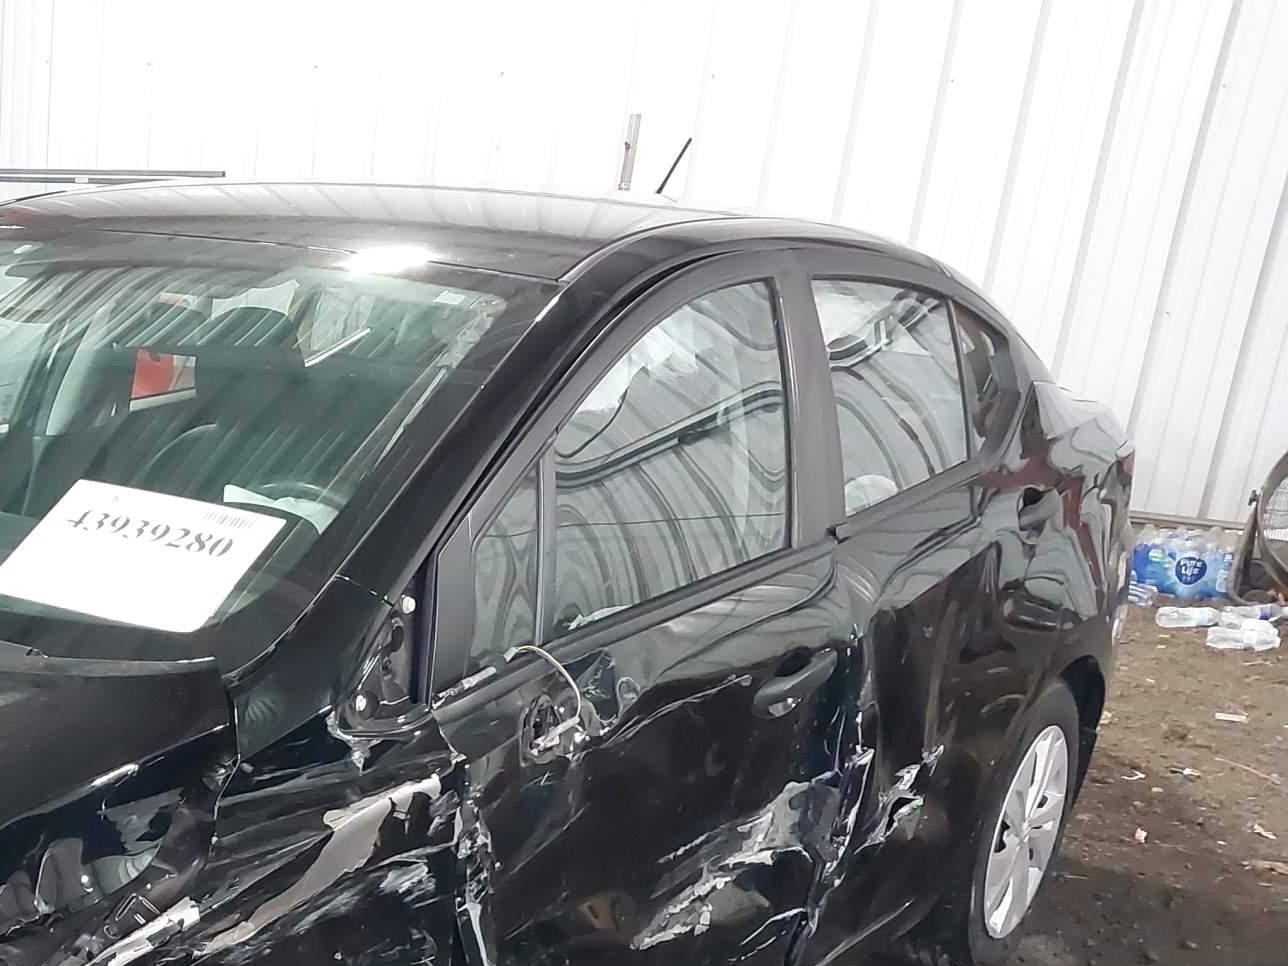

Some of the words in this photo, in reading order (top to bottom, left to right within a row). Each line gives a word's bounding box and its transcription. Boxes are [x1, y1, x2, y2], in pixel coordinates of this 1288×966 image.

[67, 509, 234, 557] 43939280
[1180, 559, 1203, 568] Pure
[1181, 566, 1200, 577] Life
